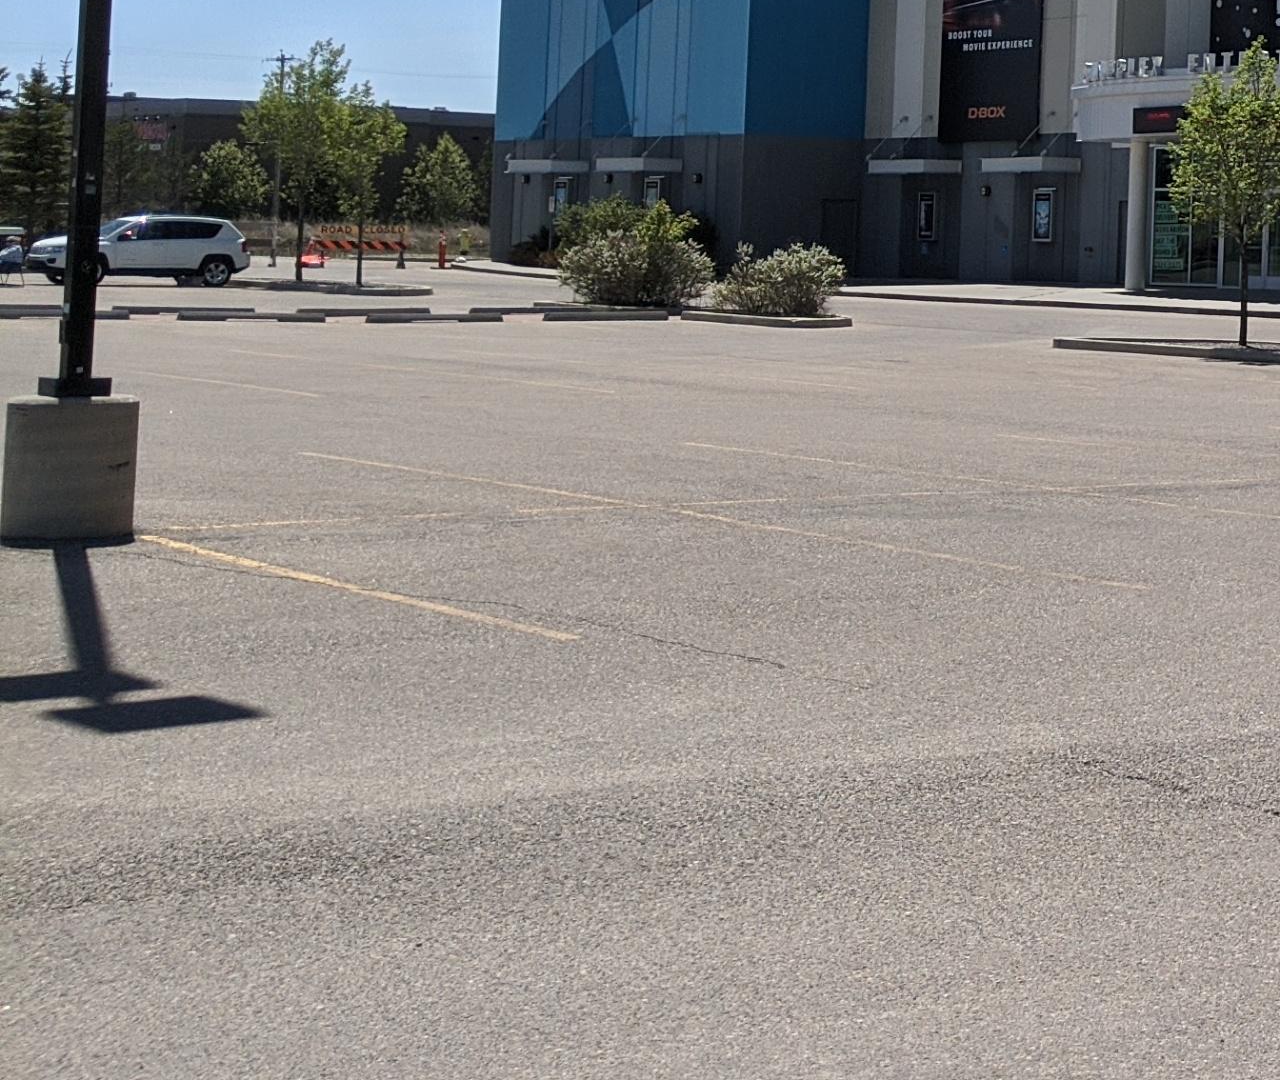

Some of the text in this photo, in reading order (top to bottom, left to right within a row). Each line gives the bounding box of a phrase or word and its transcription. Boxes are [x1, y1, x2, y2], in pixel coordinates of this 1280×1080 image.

[948, 29, 992, 40] BOOST YOUR
[963, 39, 1033, 52] MOVIE EXPERIENCE
[321, 225, 406, 234] ROAD CLOSED
